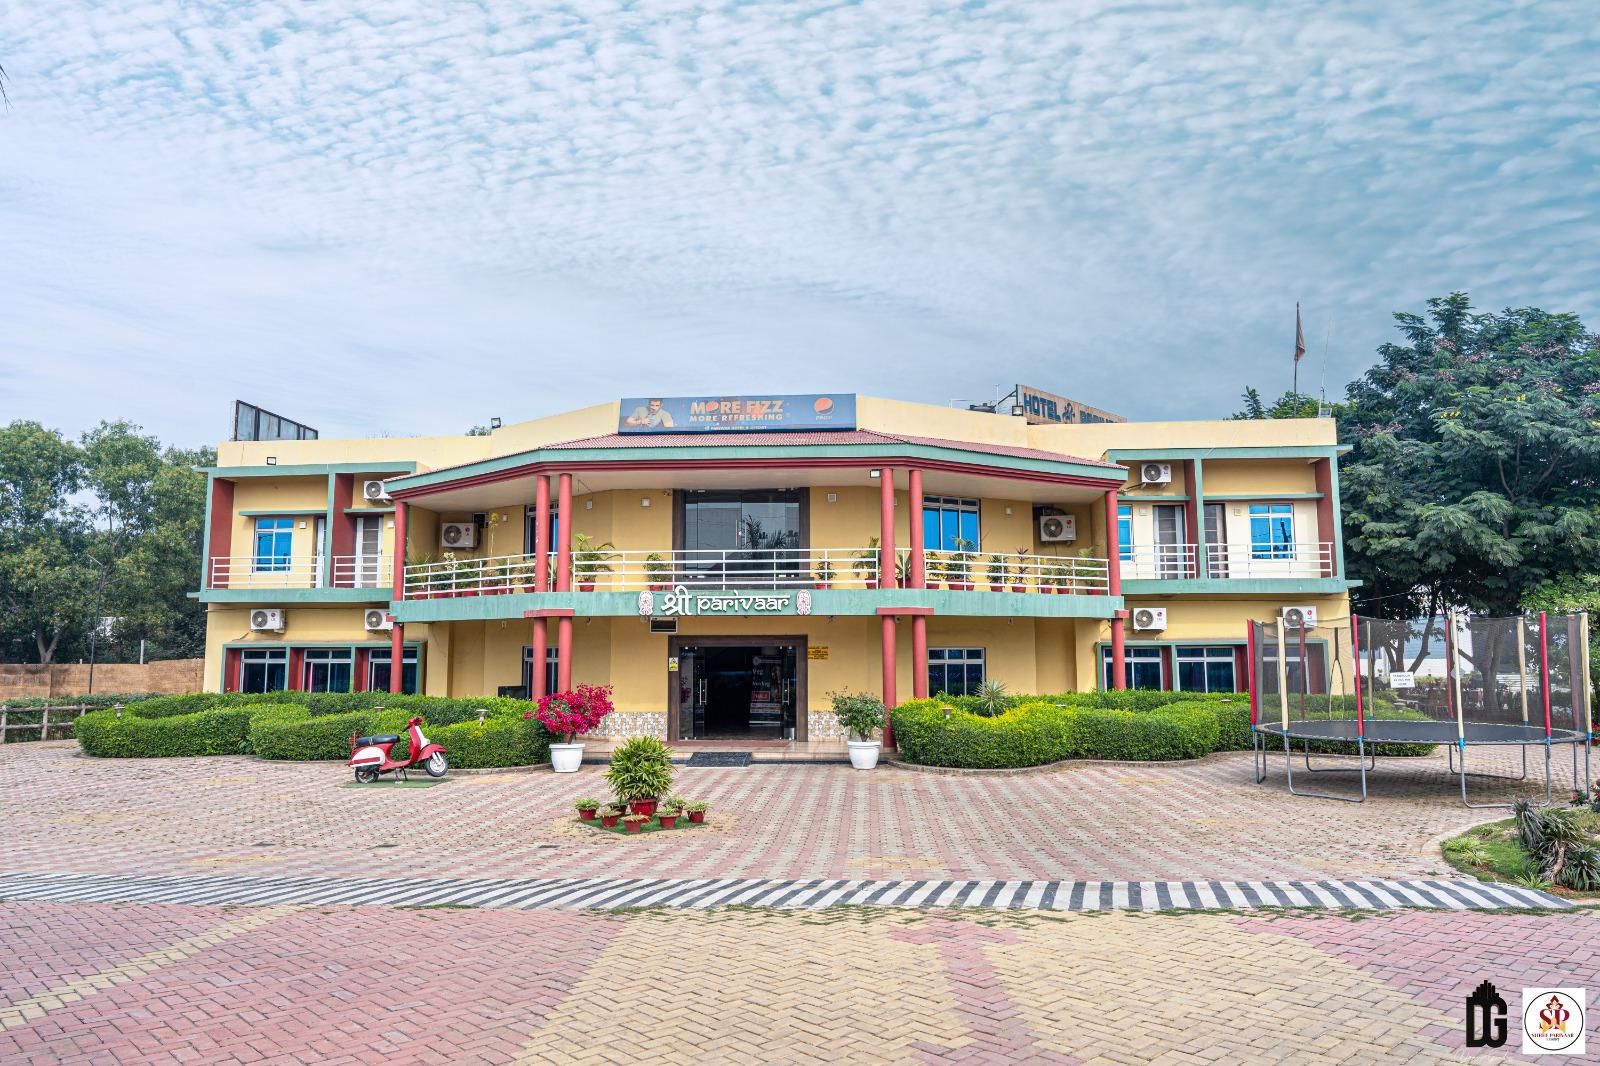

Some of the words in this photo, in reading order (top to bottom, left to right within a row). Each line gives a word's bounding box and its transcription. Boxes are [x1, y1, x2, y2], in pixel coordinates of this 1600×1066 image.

[690, 401, 740, 414] MORE
[747, 400, 784, 414] FIZZ
[1024, 392, 1060, 421] HOTEL
[721, 414, 783, 422] REFRESHING
[661, 585, 692, 615] श्री
[697, 590, 790, 615] parivaar
